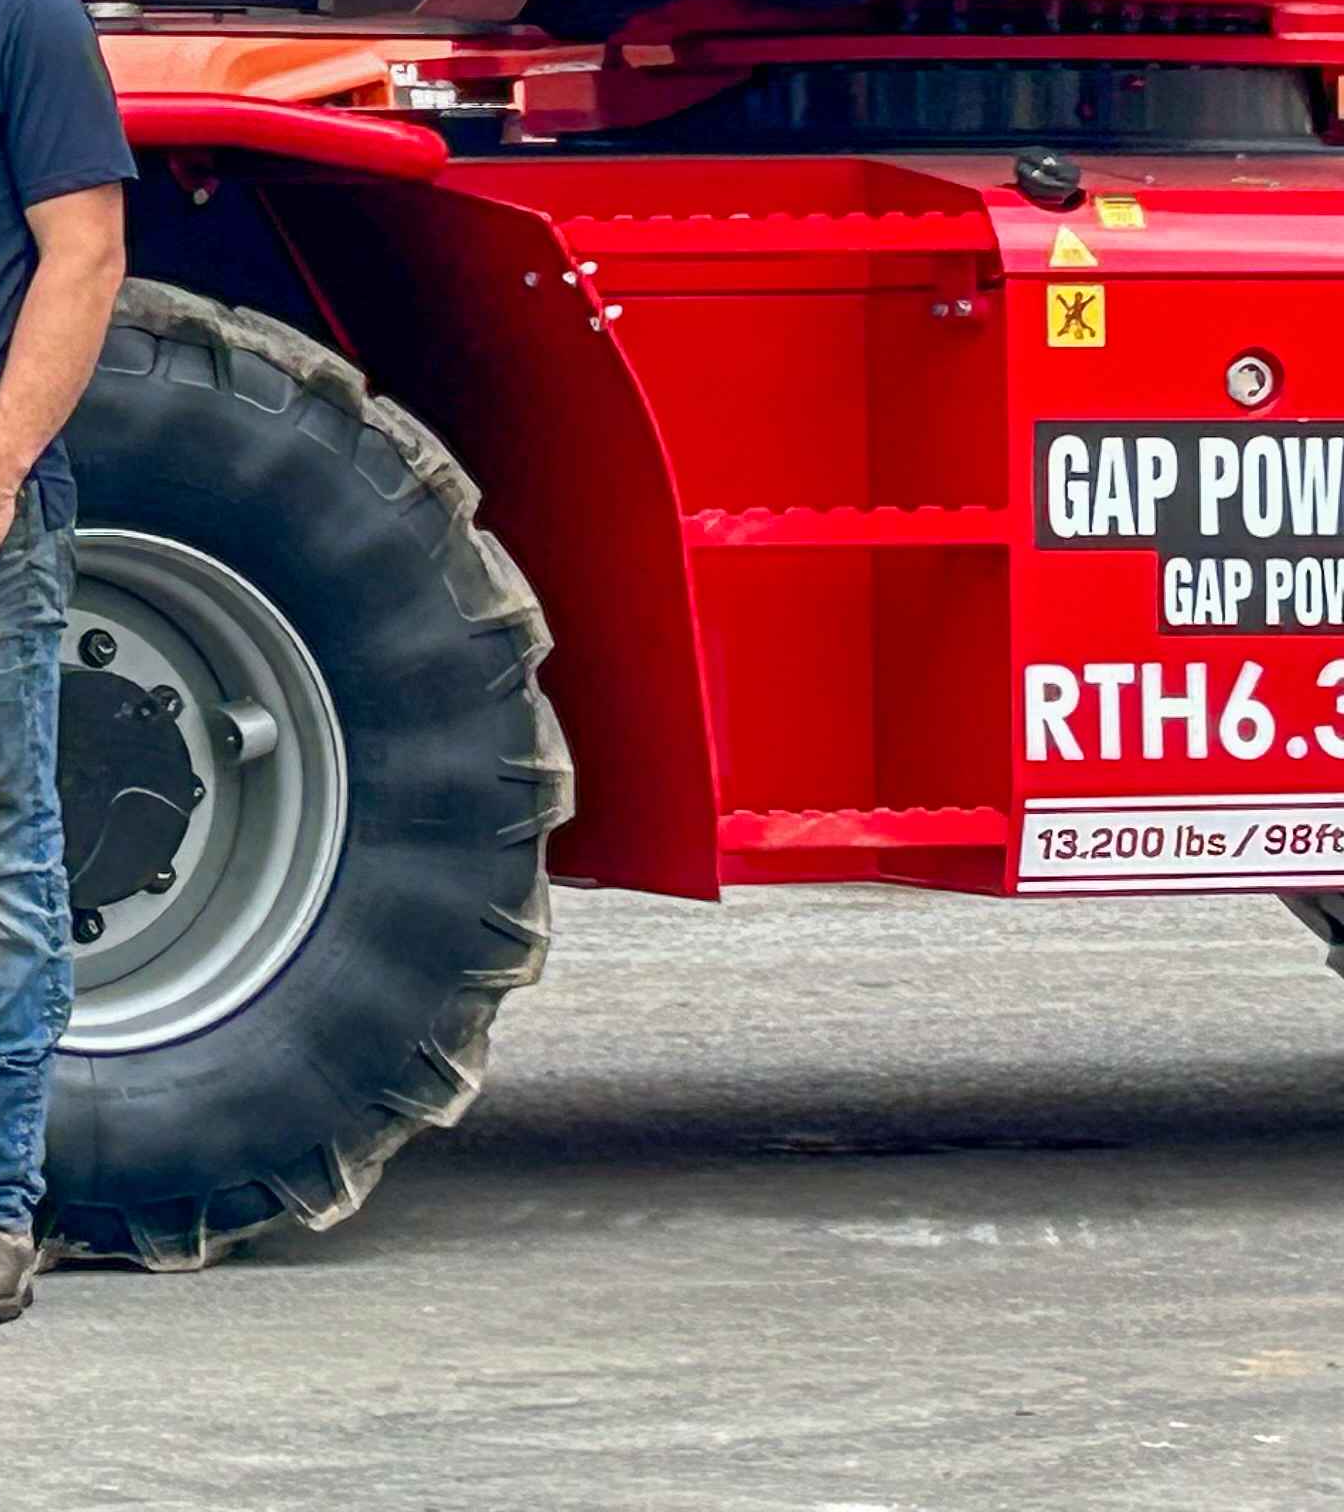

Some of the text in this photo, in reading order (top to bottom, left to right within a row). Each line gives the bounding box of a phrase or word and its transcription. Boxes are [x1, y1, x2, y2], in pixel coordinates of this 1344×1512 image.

[1048, 434, 1344, 538] GAP POW
[1164, 557, 1253, 626] GAP
[1024, 658, 1344, 761] RTH6.3
